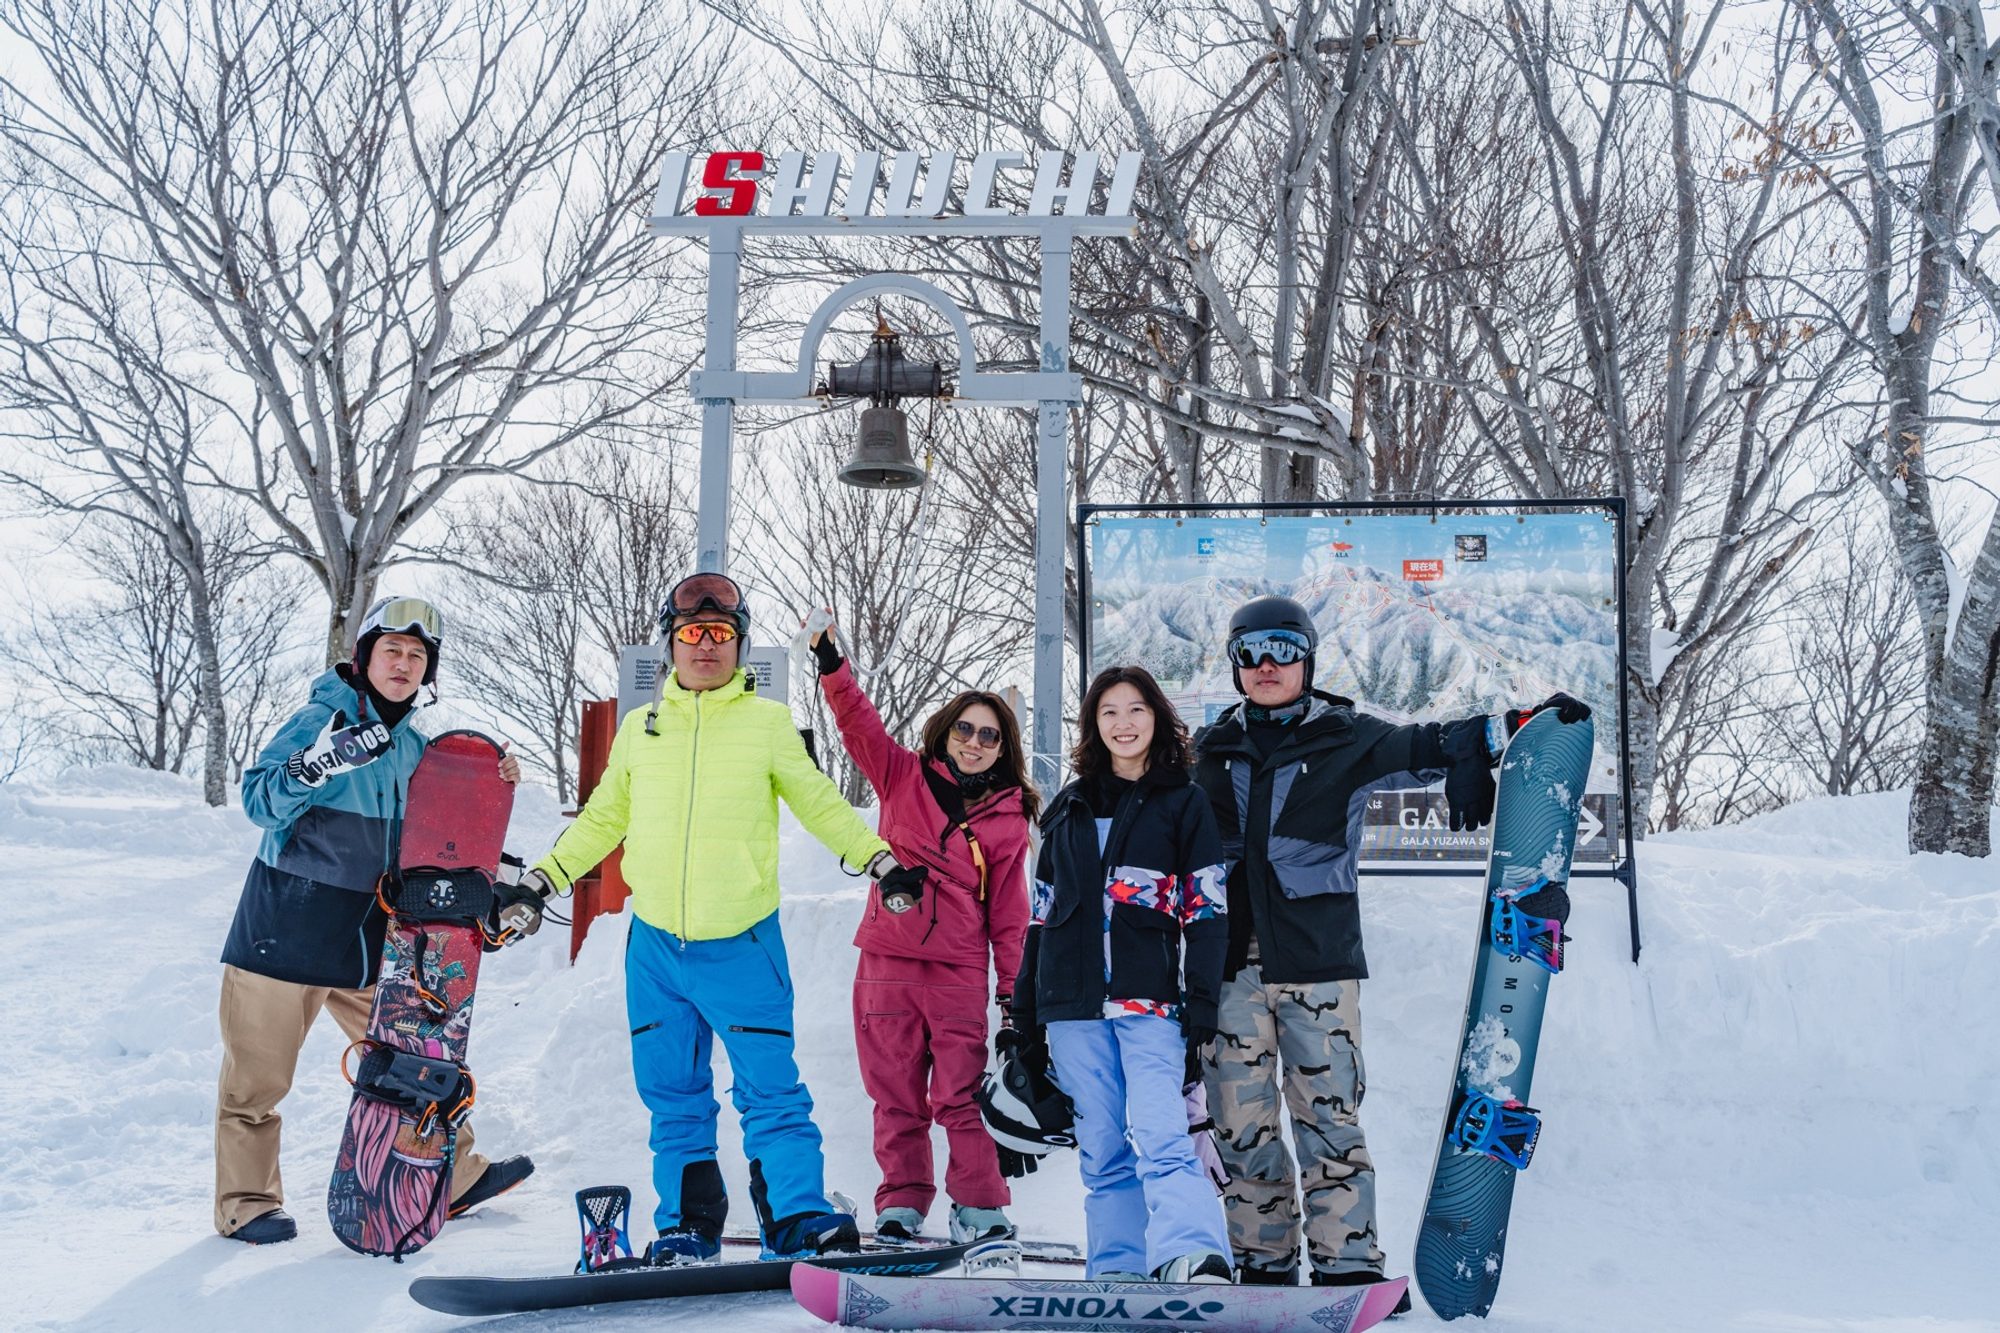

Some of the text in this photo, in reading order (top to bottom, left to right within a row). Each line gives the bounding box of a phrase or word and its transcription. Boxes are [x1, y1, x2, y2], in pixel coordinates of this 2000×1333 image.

[652, 150, 1143, 217] ISHIUCHI
[1401, 837, 1429, 846] GALA
[1432, 837, 1476, 846] YUZAWA
[989, 1296, 1129, 1318] YONEX
